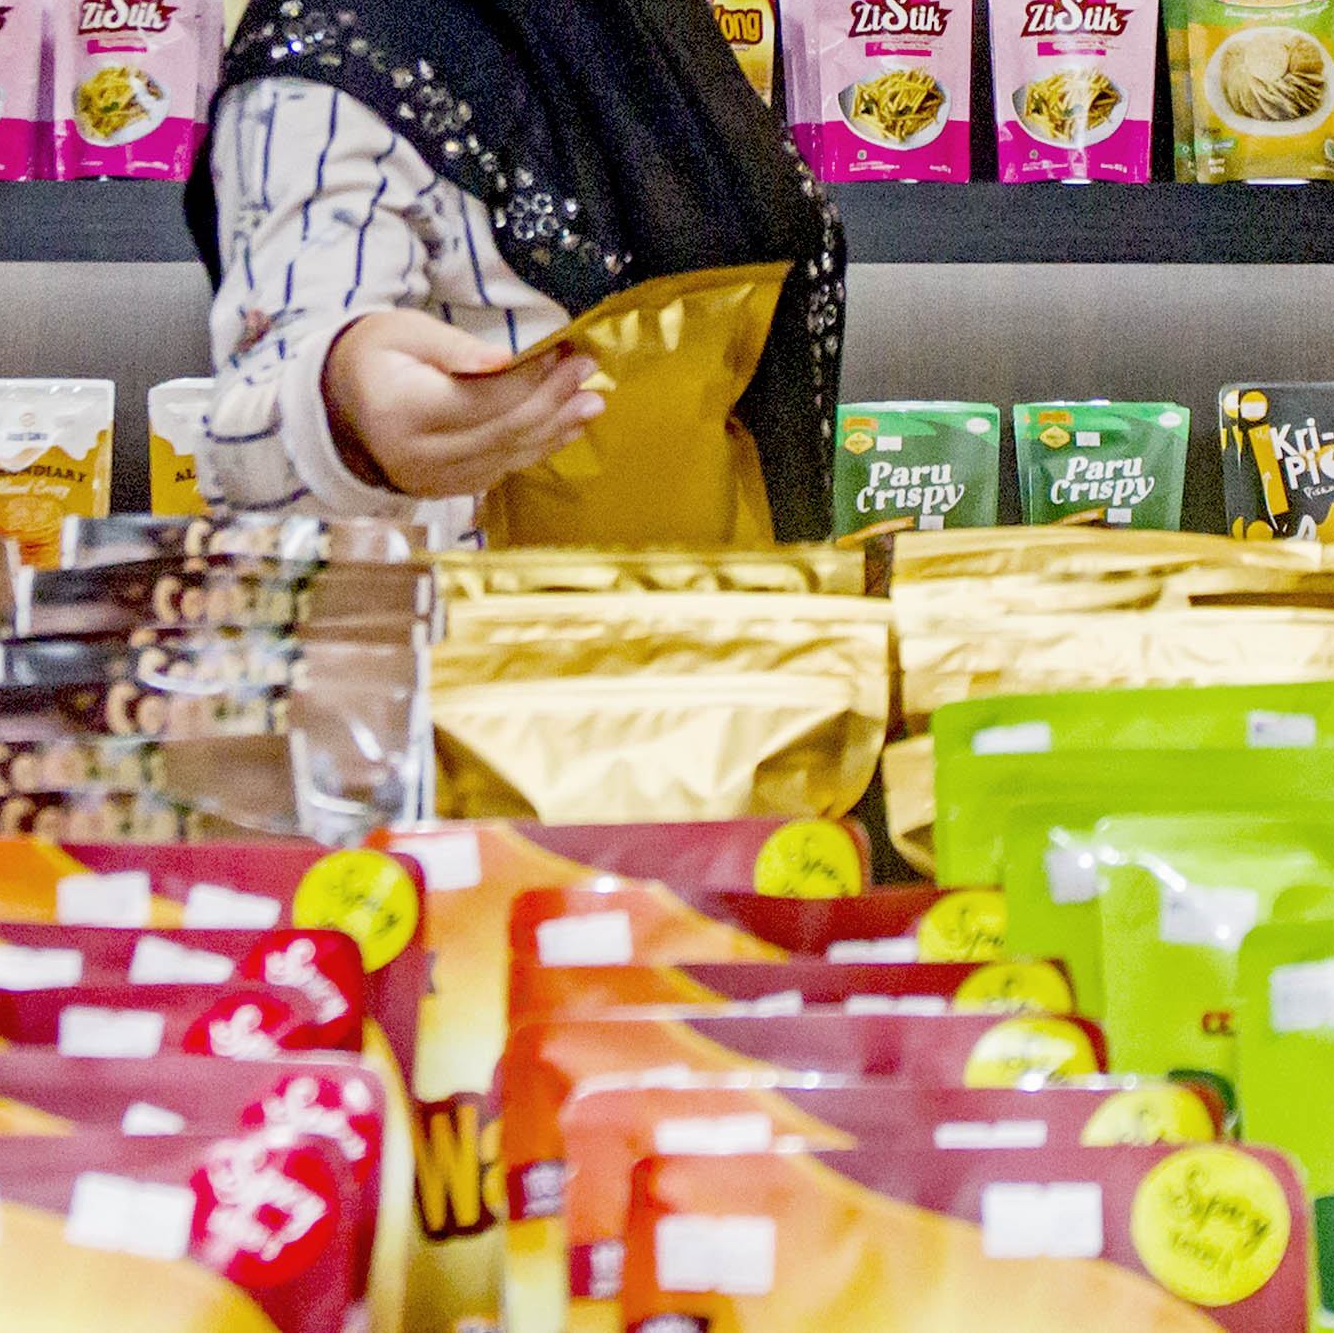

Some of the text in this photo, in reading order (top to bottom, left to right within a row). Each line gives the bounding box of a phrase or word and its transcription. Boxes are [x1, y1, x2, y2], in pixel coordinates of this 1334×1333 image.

[1270, 418, 1334, 460] Kri-
[869, 462, 951, 487] Paru
[1066, 456, 1142, 481] Paru
[856, 483, 965, 515] Crispy
[1050, 477, 1155, 506] Crispy
